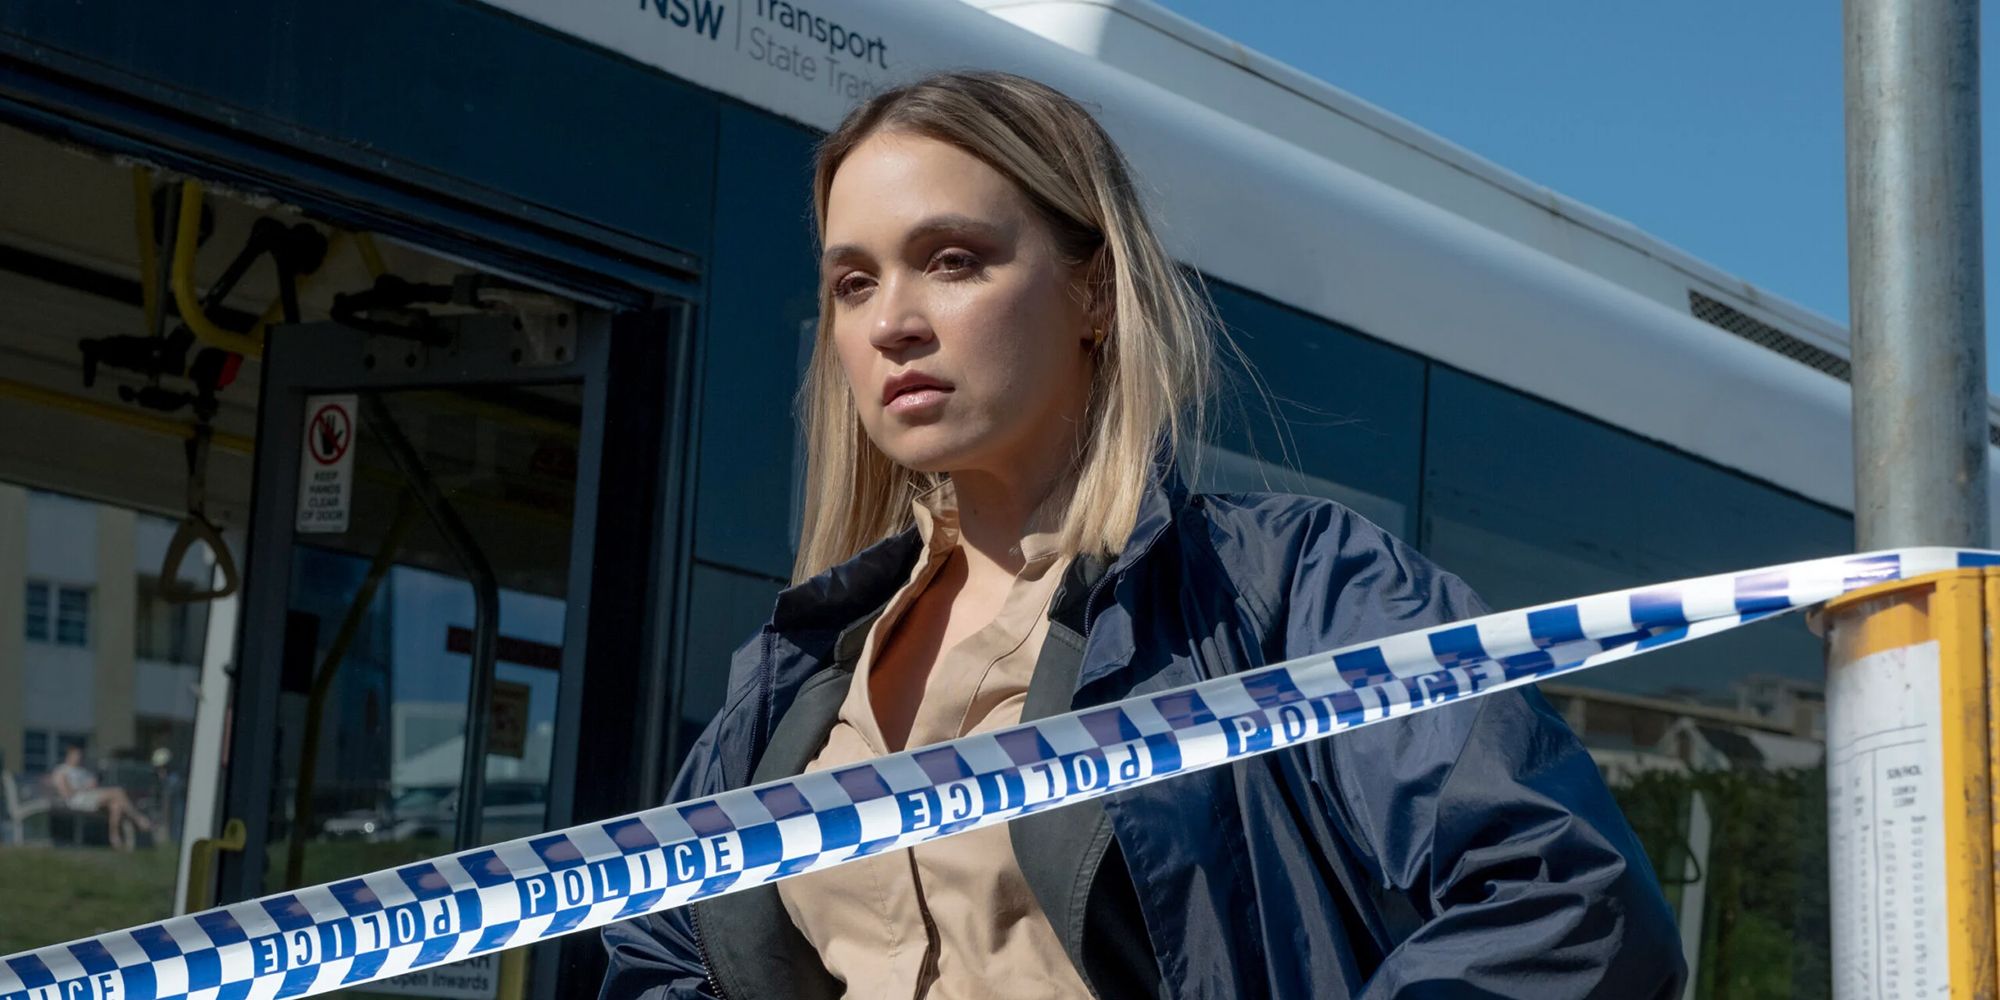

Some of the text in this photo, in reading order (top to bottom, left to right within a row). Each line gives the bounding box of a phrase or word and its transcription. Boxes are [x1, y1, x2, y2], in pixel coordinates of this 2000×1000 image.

[750, 26, 816, 82] State
[309, 483, 341, 495] HANDS
[309, 496, 340, 508] CLEAR
[314, 470, 338, 481] KEEP
[315, 510, 343, 522] DOOR
[1231, 660, 1495, 753] POLICE
[909, 744, 1141, 830] POLICE
[527, 836, 732, 914] POLICE
[263, 899, 452, 975] POLICE
